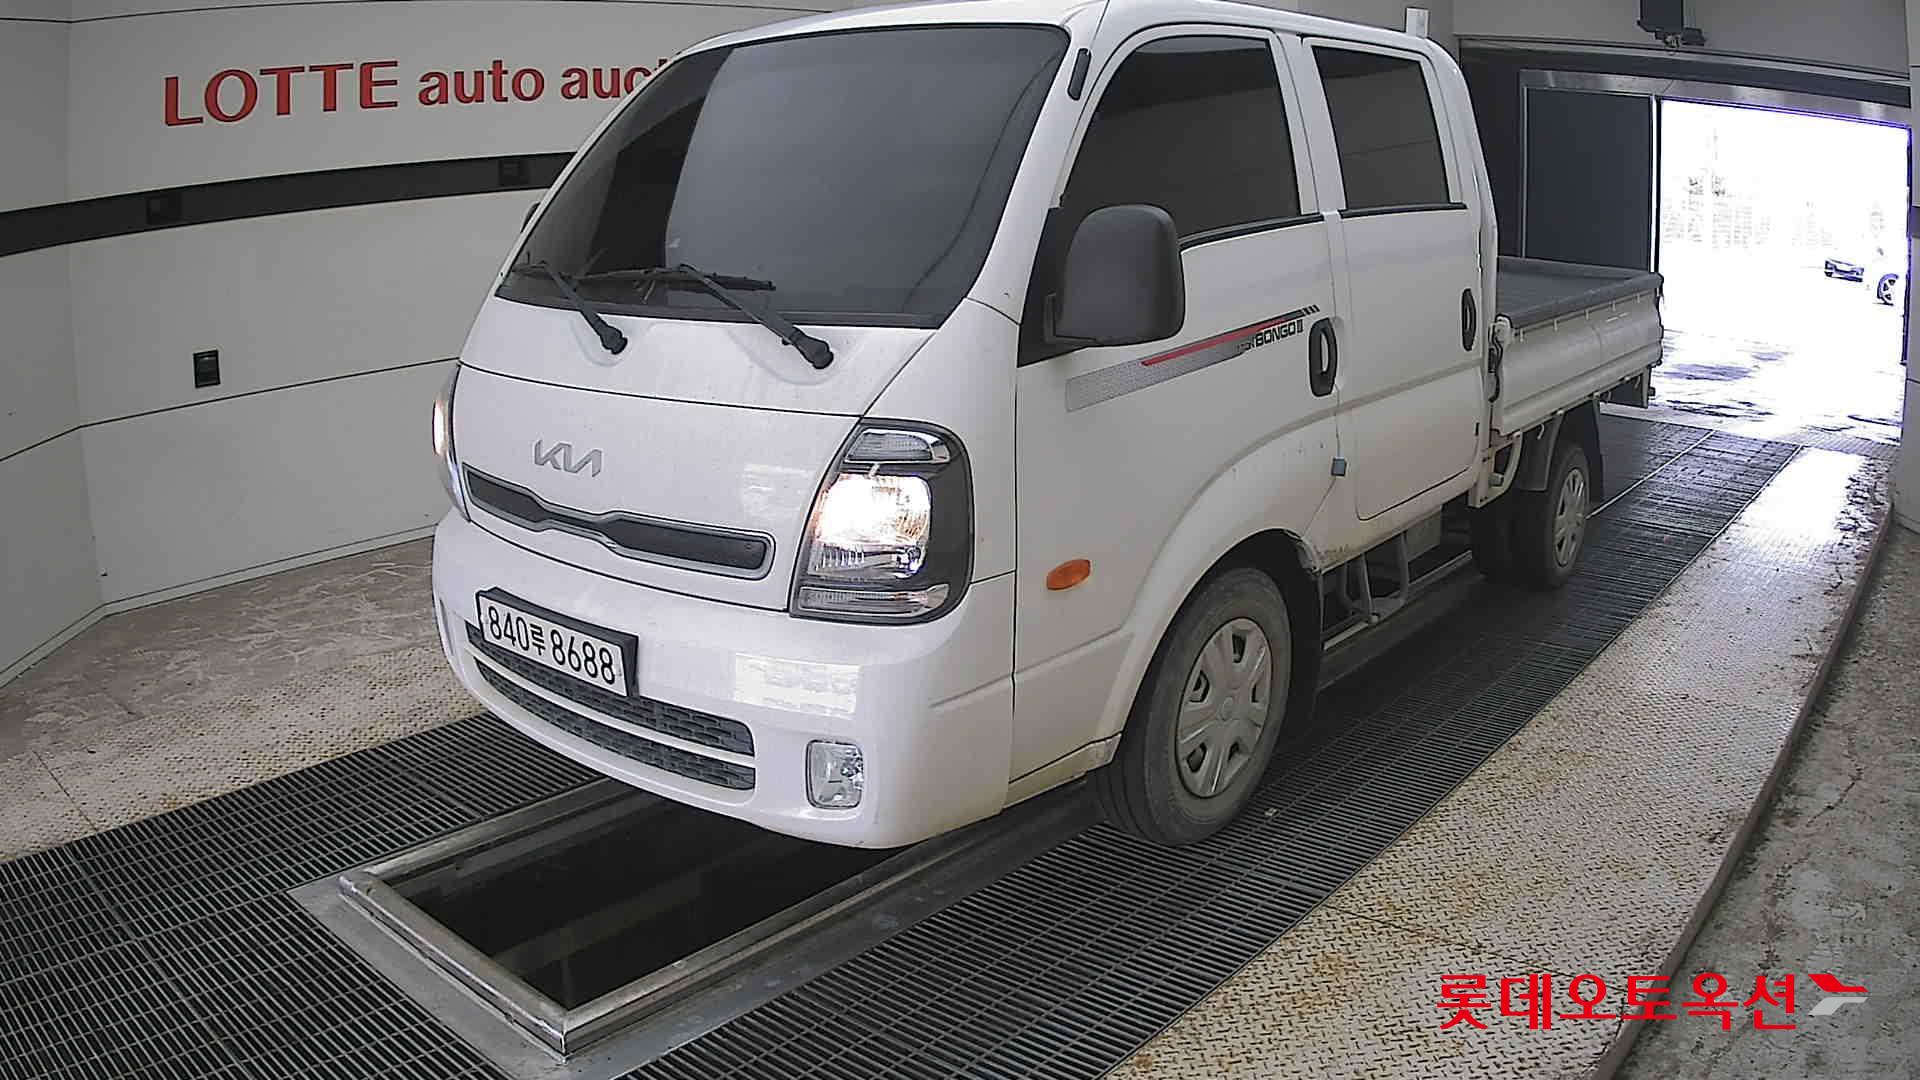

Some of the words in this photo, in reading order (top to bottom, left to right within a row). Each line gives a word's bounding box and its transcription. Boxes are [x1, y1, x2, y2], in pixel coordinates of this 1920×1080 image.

[165, 60, 398, 126] LOTTE
[418, 59, 545, 106] auto
[534, 439, 602, 477] KIA
